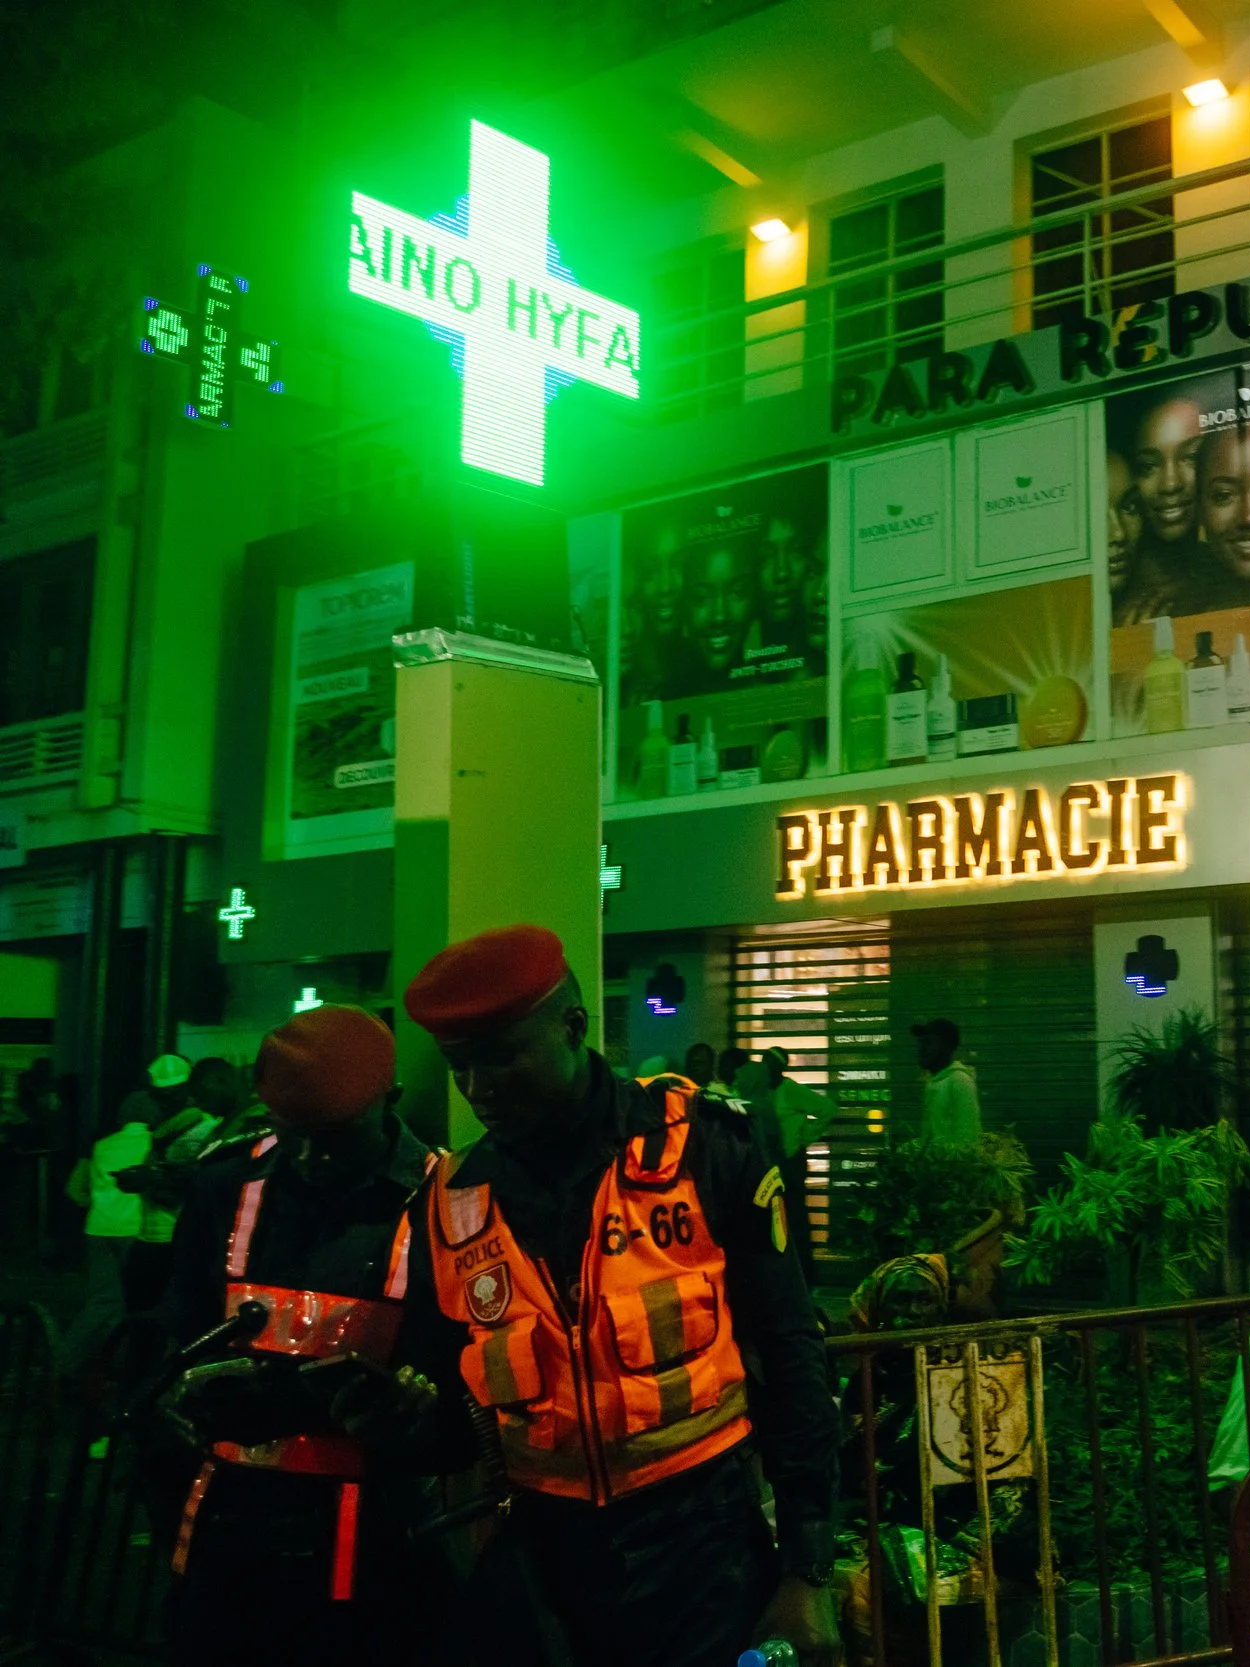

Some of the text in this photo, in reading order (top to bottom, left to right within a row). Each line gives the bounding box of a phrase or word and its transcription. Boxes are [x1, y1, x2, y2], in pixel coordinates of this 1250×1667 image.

[831, 339, 1037, 435] PARA
[775, 774, 1186, 898] PHARMACIE
[453, 1235, 507, 1276] POLICE
[601, 1201, 694, 1257] 6-66
